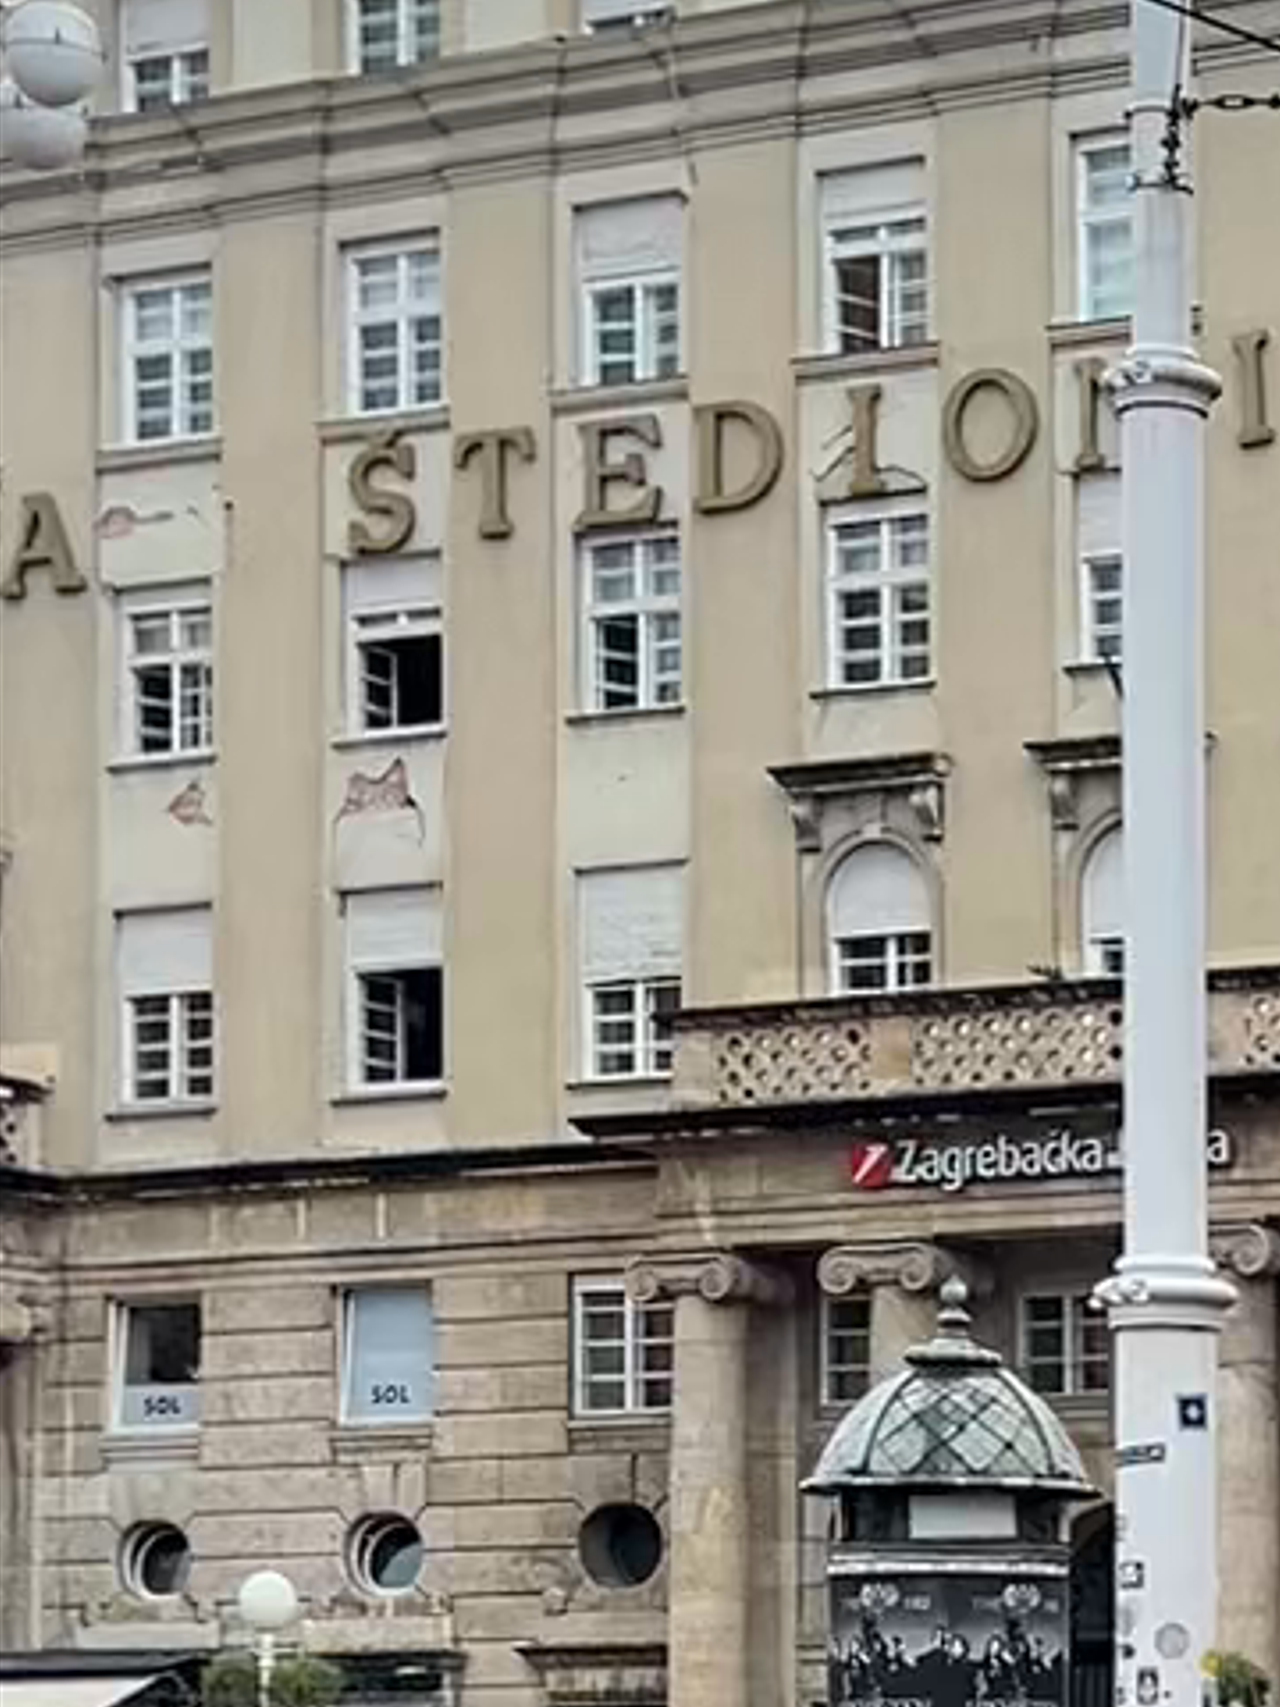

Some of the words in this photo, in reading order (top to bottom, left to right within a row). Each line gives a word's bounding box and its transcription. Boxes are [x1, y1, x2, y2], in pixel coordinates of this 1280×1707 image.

[891, 1129, 1102, 1191] Zagrebačka
[371, 1384, 411, 1404] SOL
[143, 1396, 182, 1415] SOL
